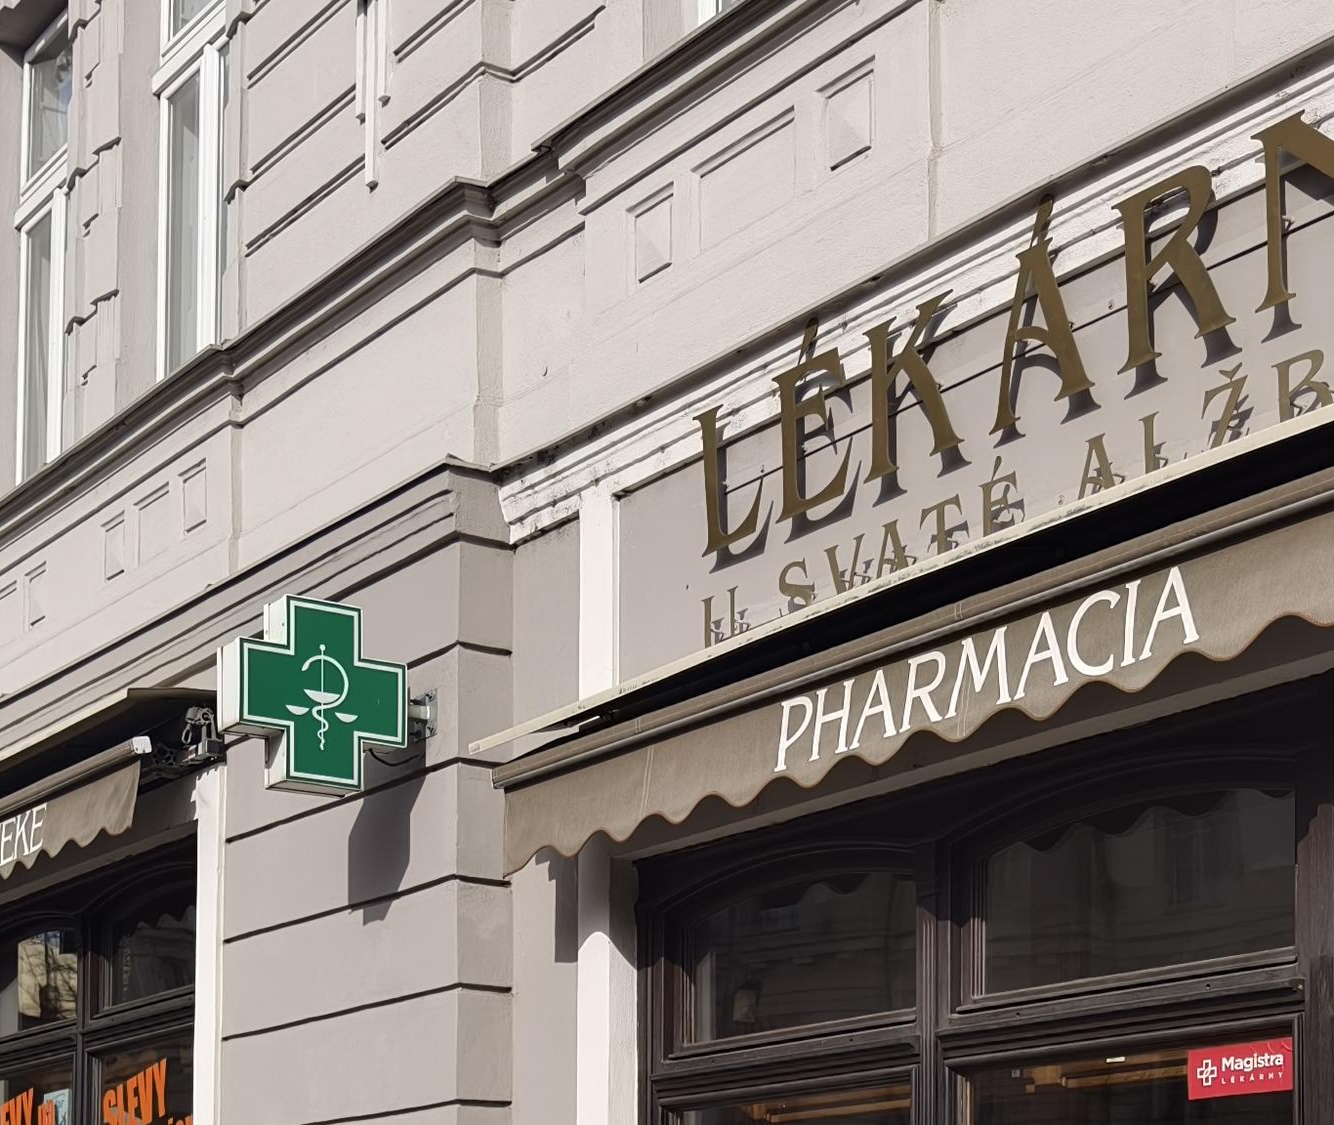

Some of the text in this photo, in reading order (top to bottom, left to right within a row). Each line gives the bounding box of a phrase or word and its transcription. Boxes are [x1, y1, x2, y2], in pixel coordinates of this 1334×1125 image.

[778, 457, 1020, 610] SVATÉ
[774, 567, 1200, 772] PHARMACIA
[1221, 1053, 1284, 1072] Magistra
[1221, 1072, 1284, 1085] LÉKÁRNY
